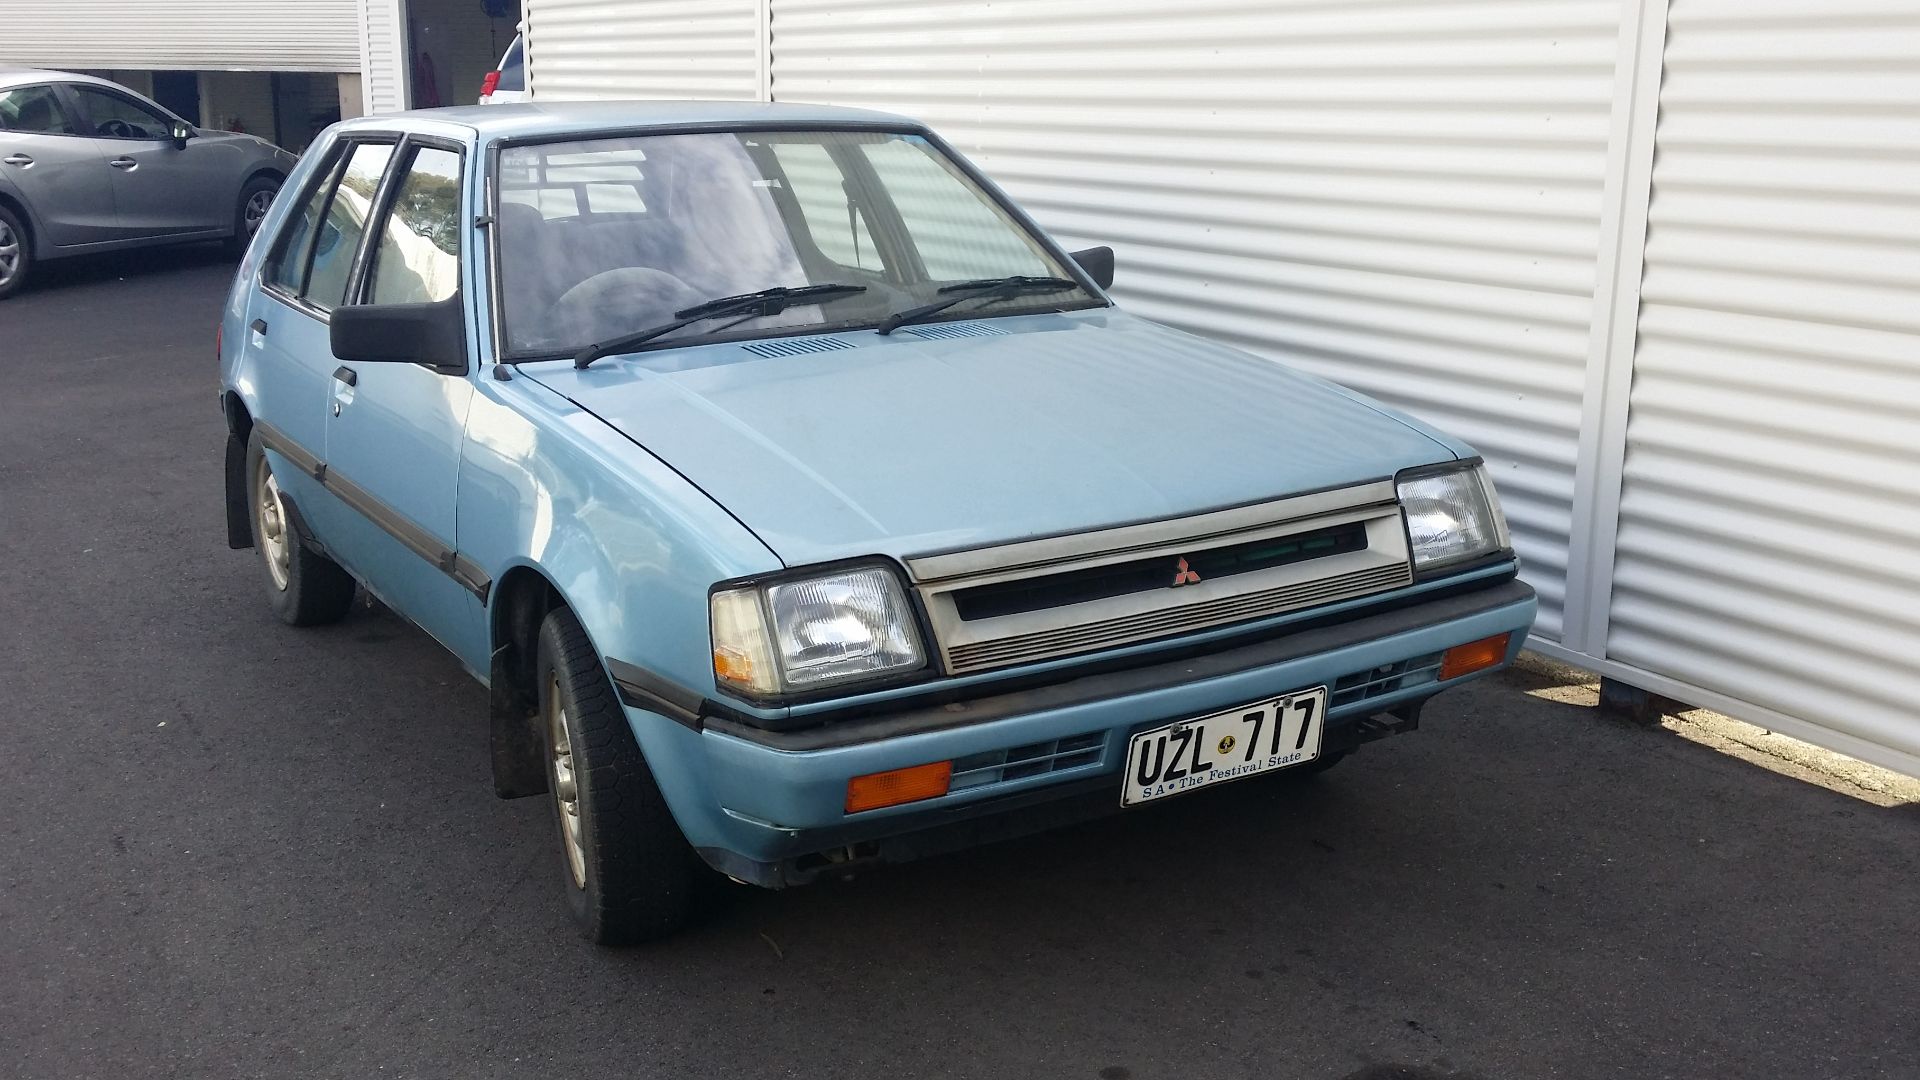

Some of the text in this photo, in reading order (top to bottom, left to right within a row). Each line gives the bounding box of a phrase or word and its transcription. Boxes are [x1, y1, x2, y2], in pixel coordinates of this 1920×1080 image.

[1137, 697, 1316, 787] UZL 717
[1179, 775, 1204, 789] The
[1209, 760, 1263, 781] Festival
[1268, 751, 1302, 767] State
